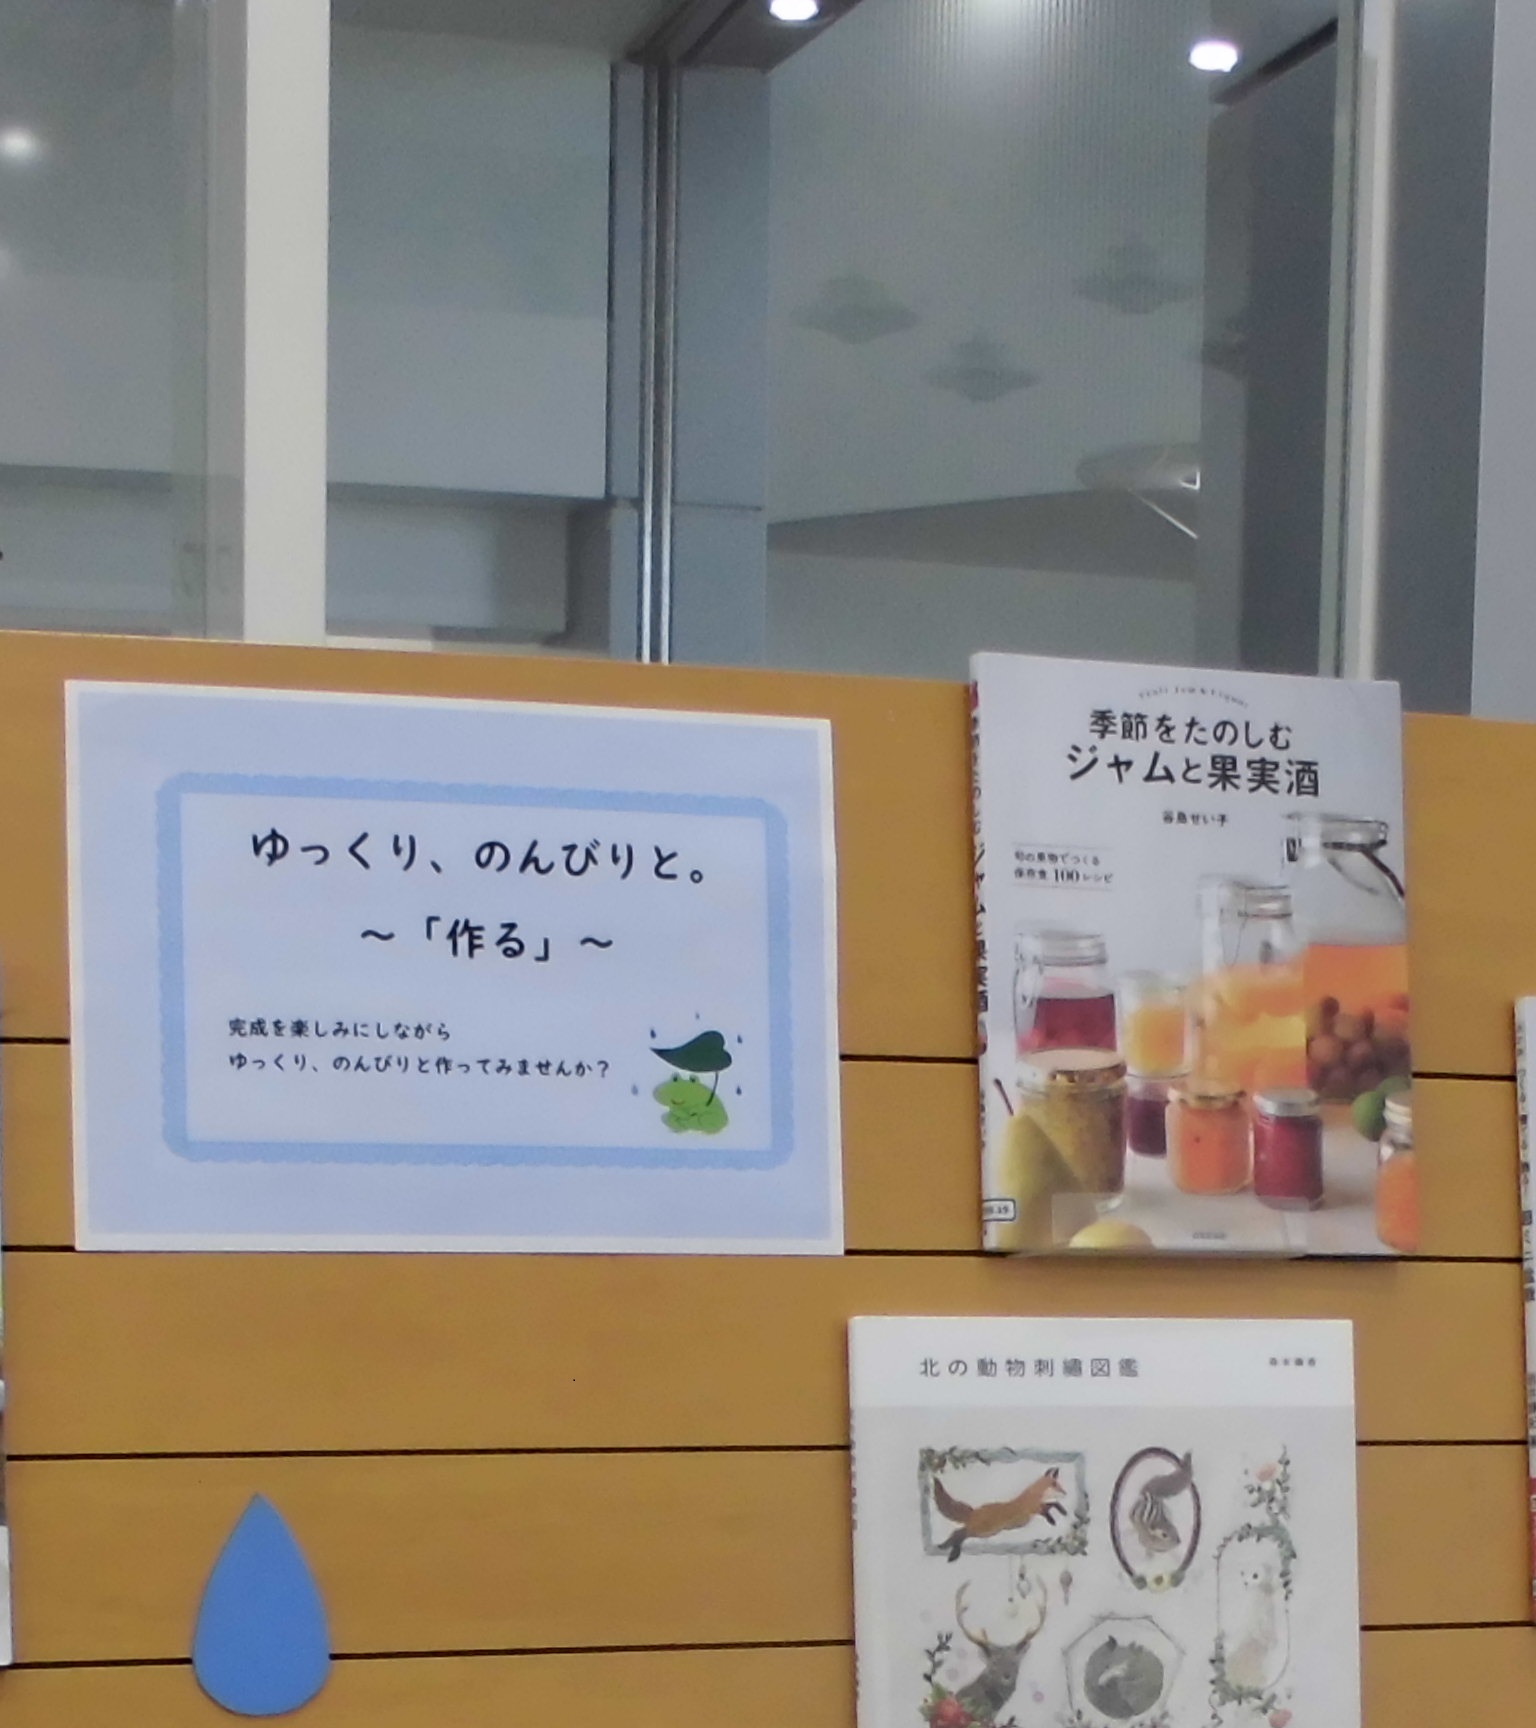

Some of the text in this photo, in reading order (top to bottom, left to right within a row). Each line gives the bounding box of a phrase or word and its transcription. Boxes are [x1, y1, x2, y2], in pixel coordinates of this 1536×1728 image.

[1088, 708, 1292, 750] 季節をたのしむ
[1066, 743, 1320, 797] ジャムと果実酒
[252, 829, 705, 885] ゆっくり、のんびりと。
[228, 1018, 451, 1041] 完成を楽しみにしながら
